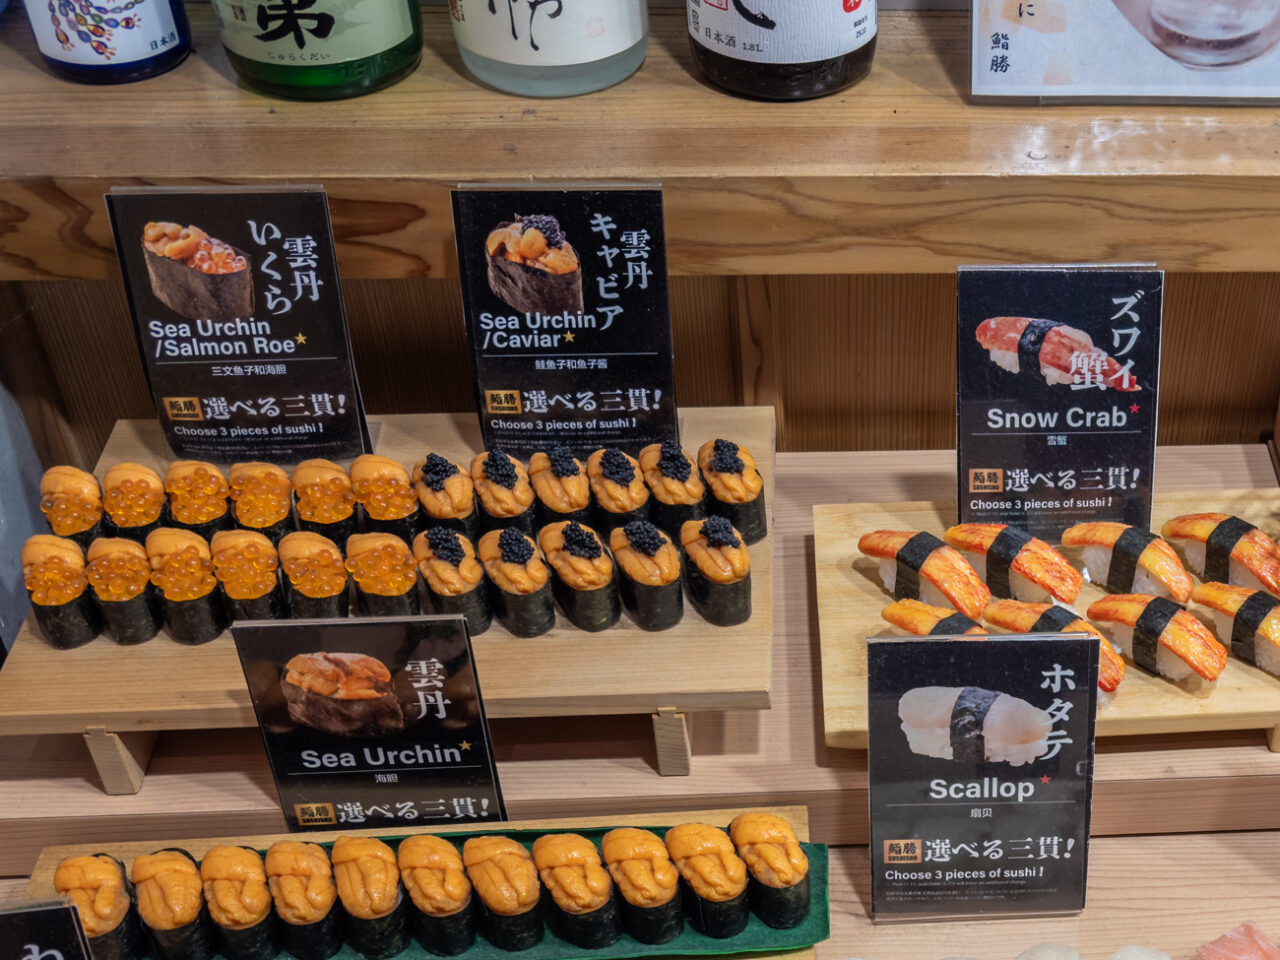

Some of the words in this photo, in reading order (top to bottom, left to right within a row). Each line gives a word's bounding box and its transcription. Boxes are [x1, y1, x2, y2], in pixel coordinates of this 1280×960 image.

[150, 32, 177, 50] 日本酒
[704, 27, 736, 48] 日本酒
[267, 50, 330, 61] じゅらくだい
[247, 220, 291, 315] いくら
[589, 213, 624, 331] キャビア
[149, 320, 191, 338] Sea
[197, 317, 271, 337] Urchin
[479, 312, 520, 330] Sea
[526, 311, 597, 330] Urchin
[155, 338, 248, 358] /Salmon
[254, 336, 296, 354] Roe
[483, 330, 561, 349] /Caviar
[1108, 290, 1145, 389] ズワイ
[1069, 350, 1109, 391] 蟹
[490, 419, 534, 430] Choose
[536, 419, 543, 430] 3
[546, 418, 584, 432] pieces
[586, 418, 597, 429] of
[987, 408, 1060, 429] Snow
[1066, 405, 1127, 428] Crab
[970, 499, 1012, 510] Choose
[1014, 499, 1021, 509] 3
[1024, 498, 1061, 511] pieces
[1063, 497, 1074, 508] of
[404, 658, 452, 719] 雲丹
[1039, 663, 1077, 760] ホタテ
[300, 750, 357, 768] Sea
[363, 744, 462, 766] Urchin
[929, 777, 1035, 802] Scallop
[885, 869, 932, 881] Choose
[934, 869, 942, 880] 3
[945, 867, 987, 882] pieces
[989, 867, 1002, 879] of
